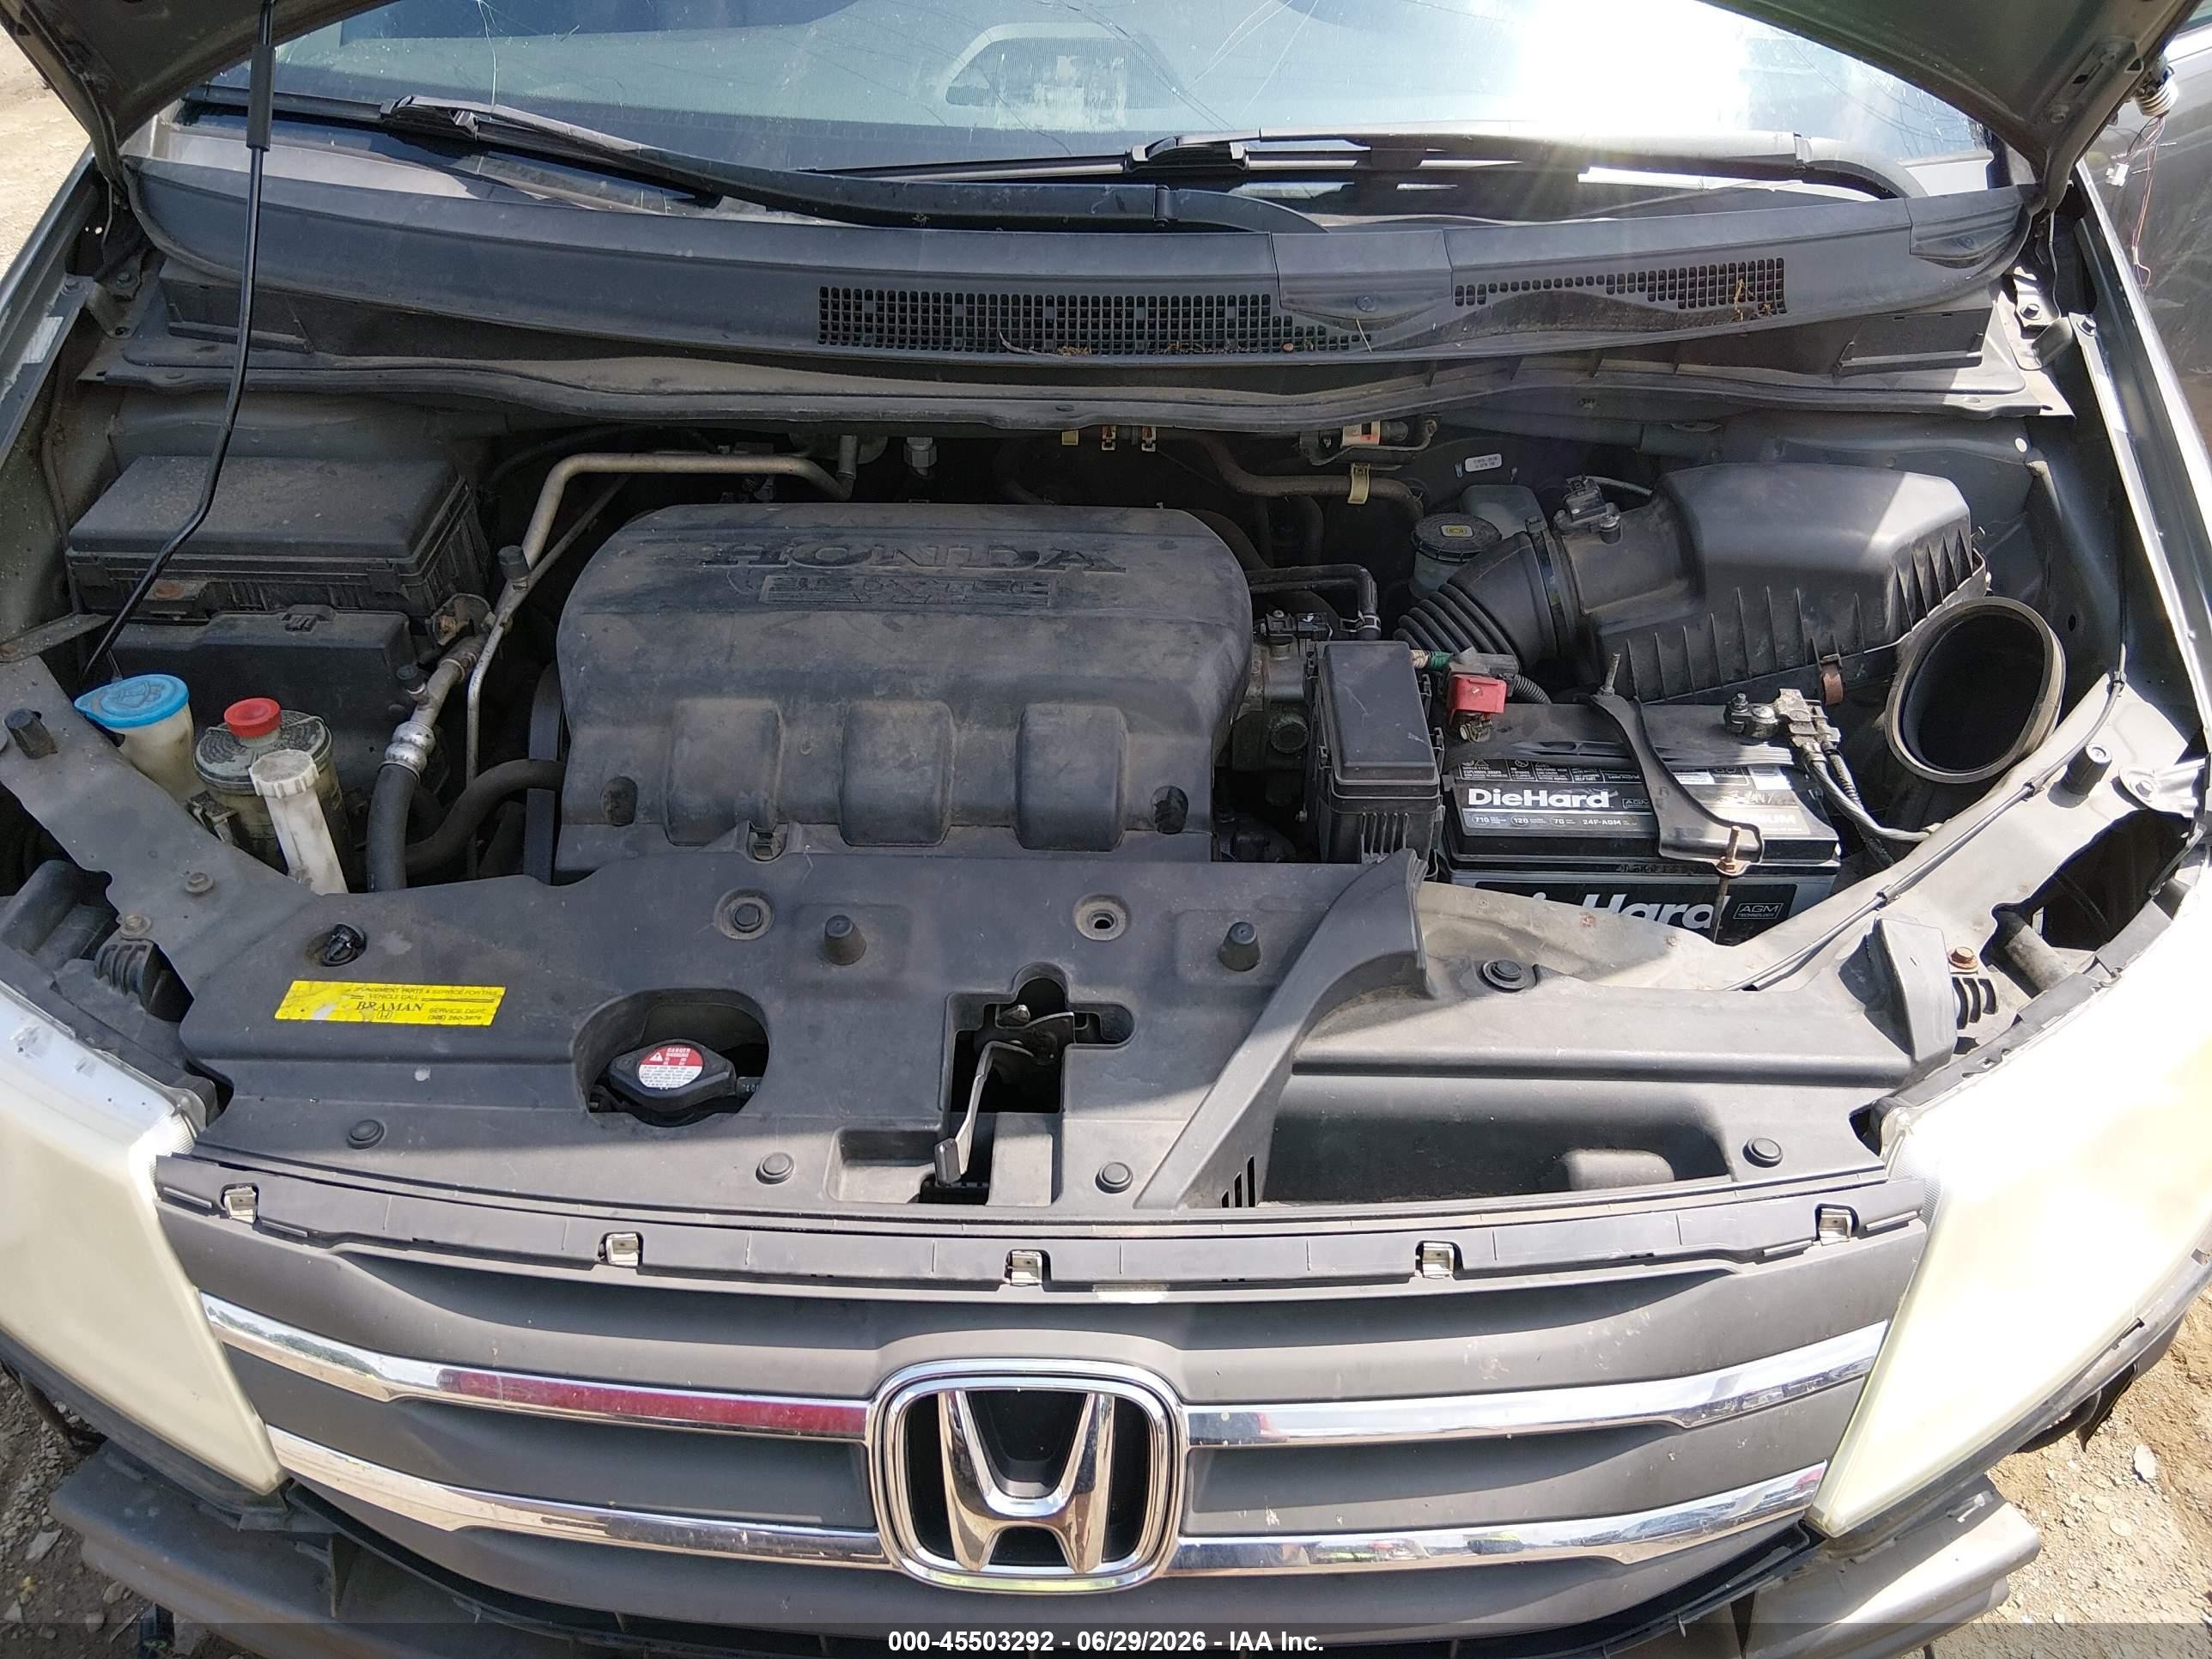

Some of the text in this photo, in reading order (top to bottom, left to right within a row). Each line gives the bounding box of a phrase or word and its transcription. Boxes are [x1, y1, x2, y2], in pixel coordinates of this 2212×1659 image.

[699, 543, 1127, 573] HONDA
[1468, 787, 1610, 808] DieHard
[356, 1001, 425, 1012] BRAMAN
